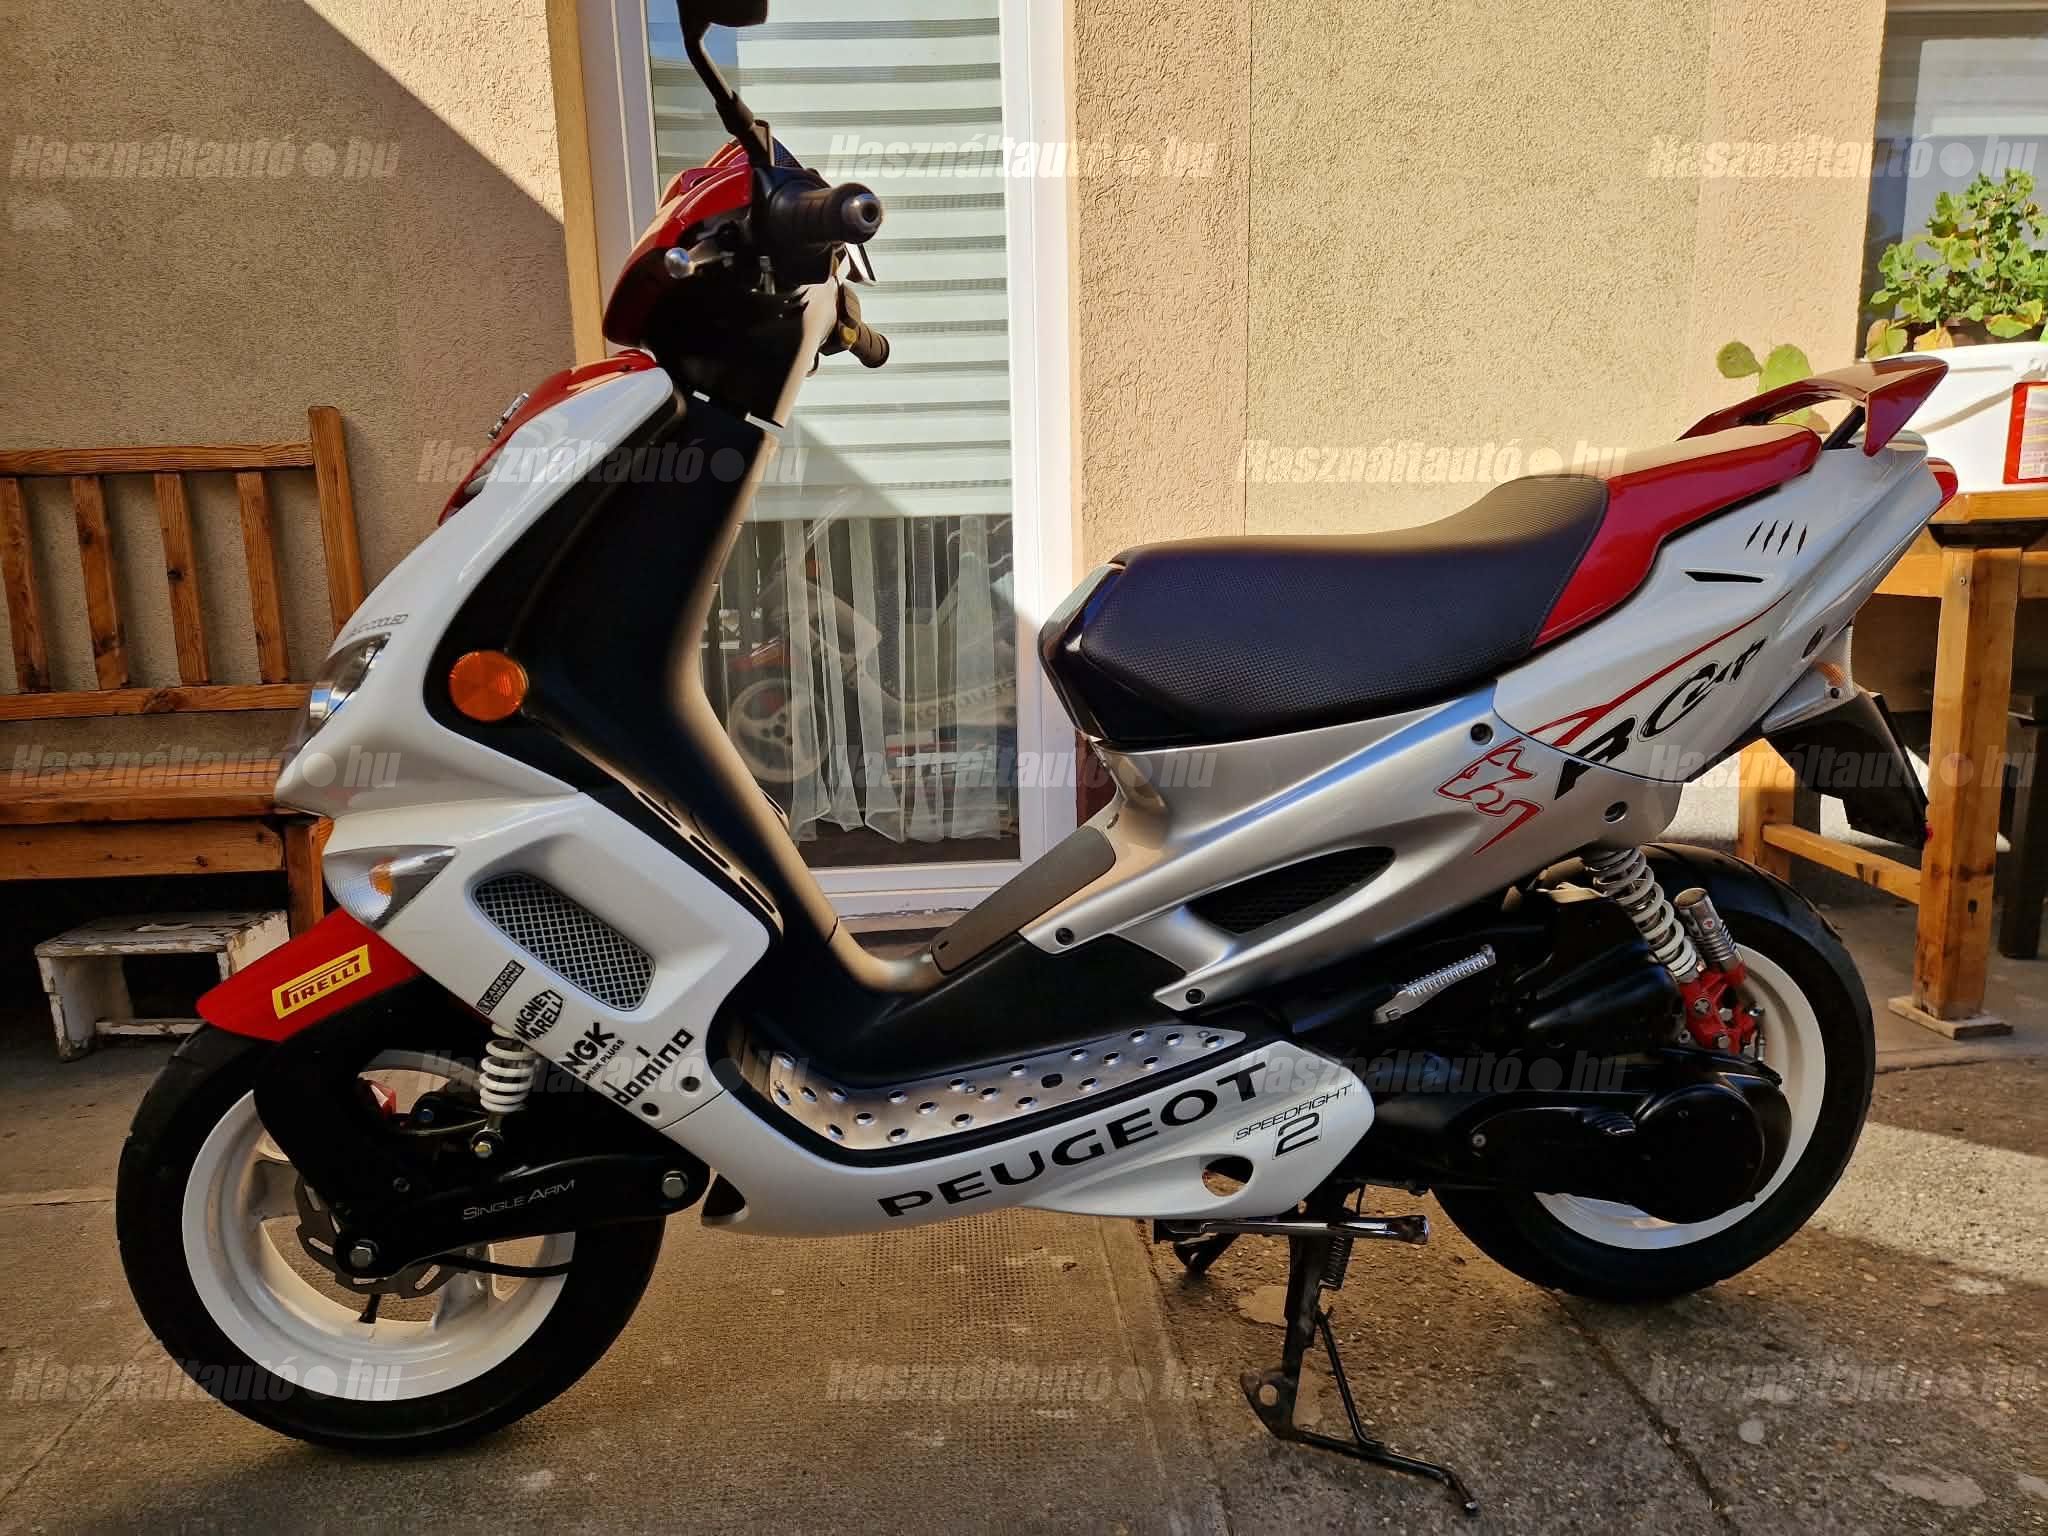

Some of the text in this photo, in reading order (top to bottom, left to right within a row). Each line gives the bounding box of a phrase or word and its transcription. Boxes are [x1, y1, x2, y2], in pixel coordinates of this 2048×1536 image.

[280, 954, 361, 1010] PIRELLI
[513, 989, 564, 1036] MAGNETI
[559, 1022, 616, 1075] NGK
[599, 1039, 625, 1063] PLUGS
[602, 1028, 695, 1106] domino
[1235, 1083, 1353, 1140] SPEEDFIGHT
[1274, 1111, 1320, 1157] 2
[876, 1061, 1266, 1217] PEUGEOT
